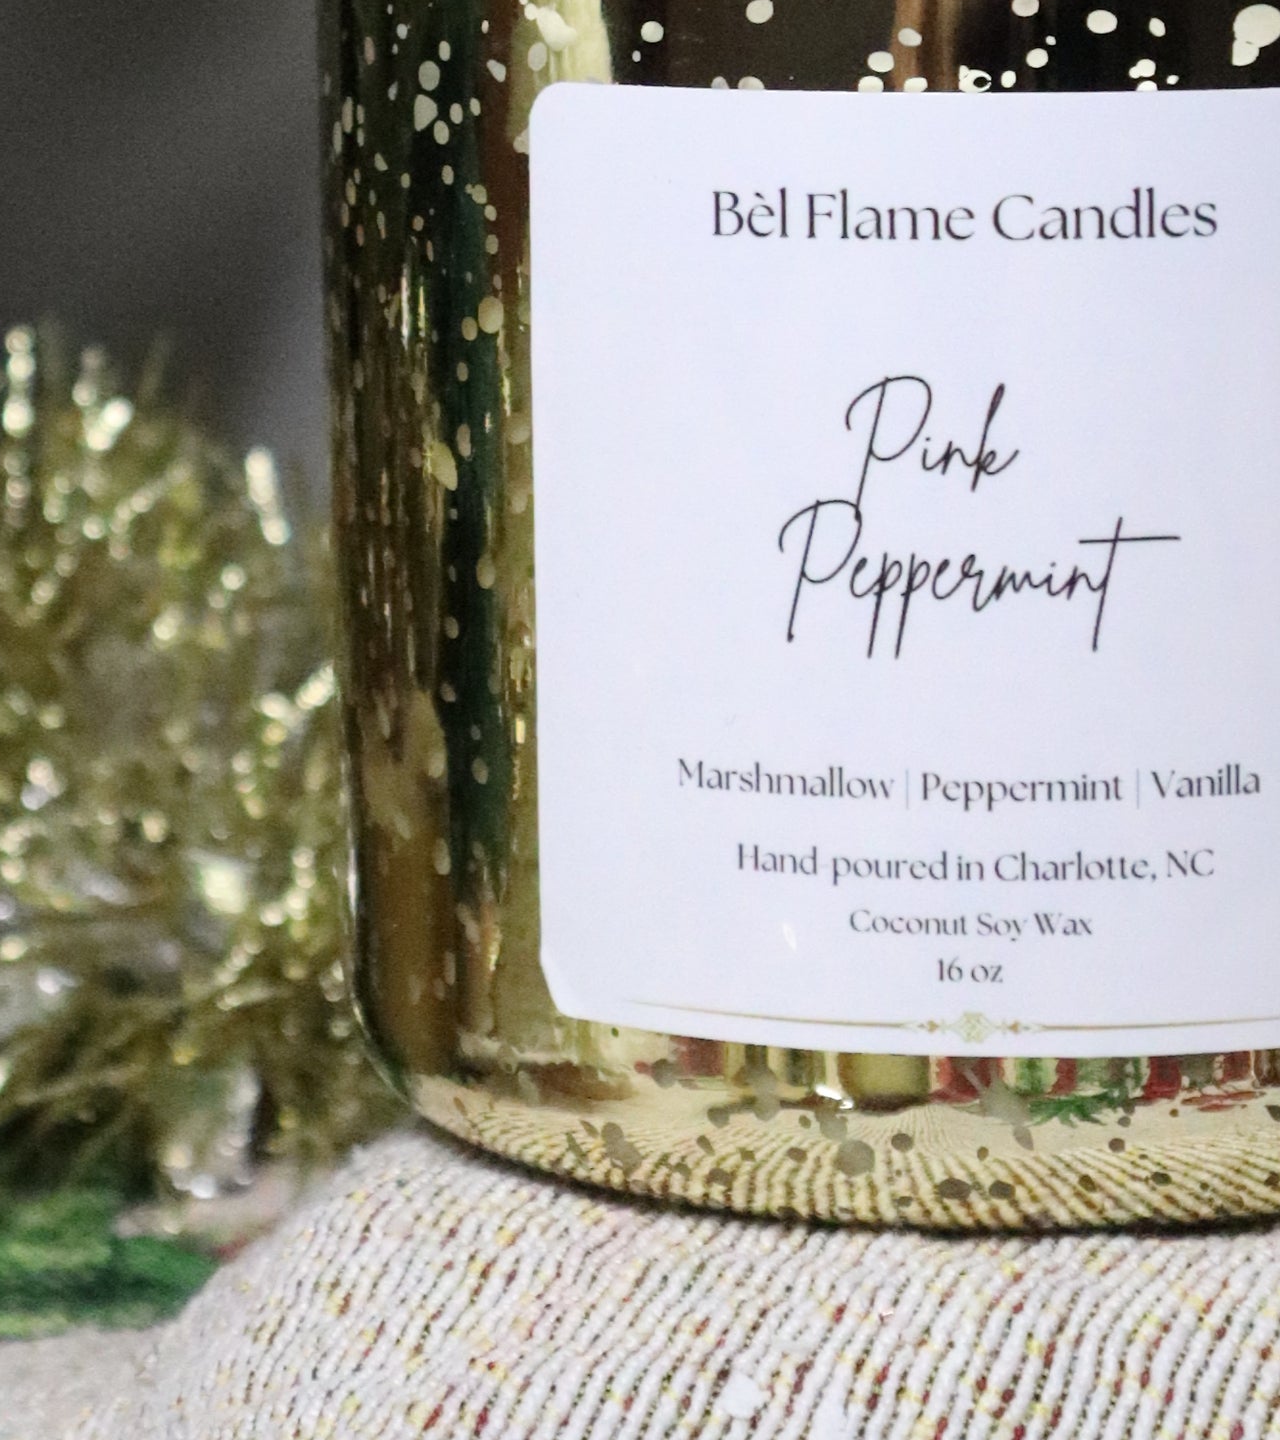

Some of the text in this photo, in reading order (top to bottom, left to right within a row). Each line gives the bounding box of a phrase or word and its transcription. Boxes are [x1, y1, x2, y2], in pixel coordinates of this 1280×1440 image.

[712, 186, 1218, 241] Bèl Flame Candles
[845, 376, 1020, 520] Pink
[778, 499, 1181, 660] Peppermint
[677, 758, 895, 800] Marshmallow
[921, 772, 1123, 813] Peppermint
[1150, 763, 1261, 799] Vanilla
[956, 854, 985, 881] in
[993, 850, 1158, 883] Charlotte,
[1165, 848, 1215, 879] NC
[849, 908, 1093, 942] Coconut Soy Wax
[936, 958, 1004, 983] 16 oz
